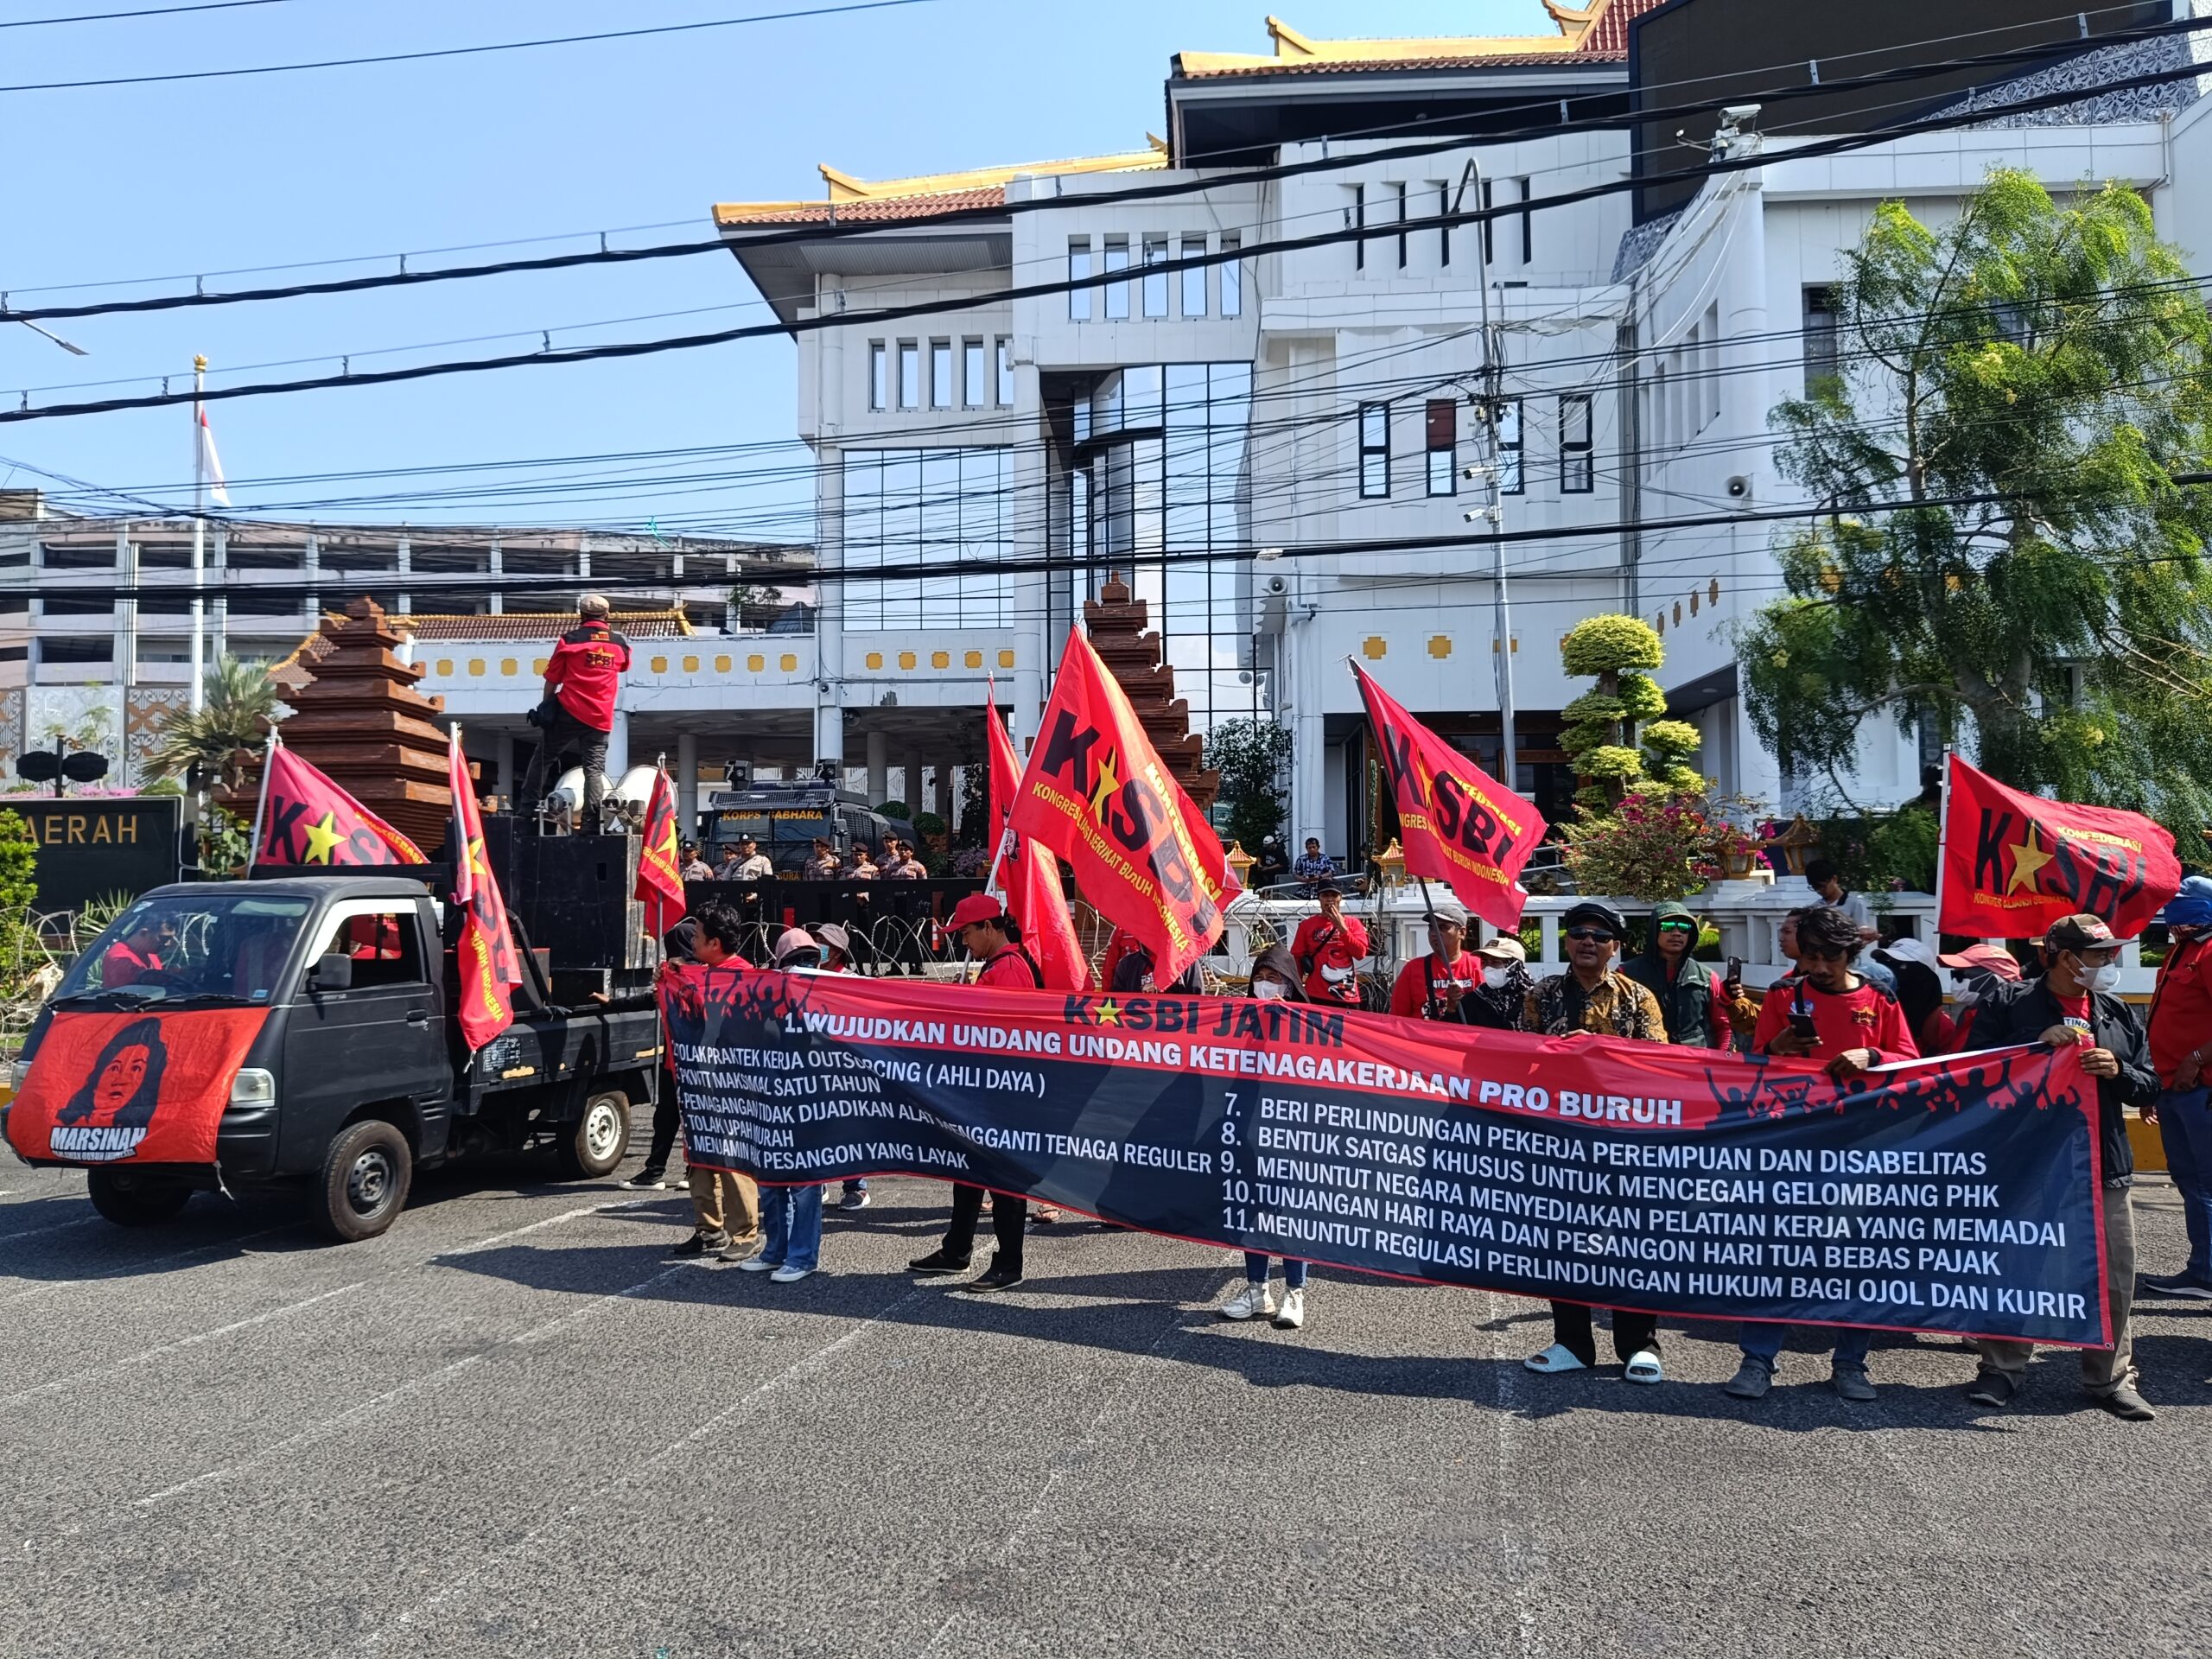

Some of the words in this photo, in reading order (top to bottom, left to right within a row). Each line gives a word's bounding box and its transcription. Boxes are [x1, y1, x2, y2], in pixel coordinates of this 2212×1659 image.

[722, 810, 761, 821] KORPS
[1032, 781, 1081, 820] KONGRES
[2056, 826, 2142, 854] KONFEDERASI
[481, 965, 505, 1022] INDONESIA
[1065, 995, 1199, 1035] KASBI
[1213, 1001, 1345, 1048] JATIM
[707, 1046, 760, 1067] PRAKTEK
[764, 1050, 804, 1071] KERJA
[712, 1071, 772, 1095] MAKSIMAL
[774, 1075, 817, 1096] SATU
[821, 1074, 881, 1093] TAHUN
[953, 1025, 1061, 1054] UNDANG
[1069, 1034, 1181, 1065] UNDANG
[1190, 1045, 1471, 1100] KETENAGAKERJAAN
[1479, 1080, 1549, 1111] PRO
[1559, 1090, 1681, 1125] BURUH
[50, 1127, 147, 1151] MARSINAH
[683, 1092, 758, 1118] PEMAGANGAN
[759, 1102, 796, 1123] TIDAK
[798, 1099, 894, 1122] DIJADIKAN
[899, 1104, 935, 1125] ALAT
[1046, 1134, 1119, 1161] TENAGA
[1124, 1143, 1211, 1174] REGULER
[687, 1115, 725, 1134] TOLAK
[723, 1118, 753, 1139] UPAH
[753, 1123, 794, 1147] MURAH
[693, 1135, 749, 1160] MENJAMIN
[764, 1144, 864, 1170] PESANGON
[865, 1142, 914, 1162] YANG
[918, 1146, 969, 1169] LAYAK
[1224, 1092, 1241, 1116] 7.
[1261, 1097, 1308, 1123] BERI
[1314, 1103, 1480, 1147] PERLINDUNGAN
[1487, 1126, 1586, 1161] PEKERJA
[1593, 1141, 1751, 1172] PEREMPUAN
[1759, 1149, 1812, 1173] DAN
[1820, 1150, 1987, 1175] DISABELITAS
[1221, 1121, 1242, 1147] 8.
[1258, 1127, 1340, 1156] BENTUK
[1344, 1136, 1427, 1168] SATGAS
[1433, 1148, 1524, 1183] KHUSUS
[1531, 1163, 1611, 1196] UNTUK
[1618, 1174, 1764, 1205] MENCEGAH
[1772, 1181, 1938, 1207] GELOMBANG
[1947, 1185, 1999, 1208] PHK
[1220, 1150, 1242, 1174] 9.
[1256, 1156, 1372, 1191] MENUNTUT
[1376, 1171, 1464, 1205] NEGARA
[1470, 1184, 1640, 1230] MENYEDIAKAN
[1649, 1209, 1765, 1237] PELATIAN
[1774, 1215, 1852, 1238] KERJA
[1857, 1217, 1925, 1240] YANG
[1933, 1217, 2066, 1247] MEMADAI
[1385, 1200, 1434, 1229] HARI
[1440, 1210, 1495, 1241] RAYA
[1502, 1221, 1548, 1249] DAN
[1556, 1230, 1694, 1263] PESANGON
[1703, 1241, 1762, 1267] HARI
[1769, 1243, 1817, 1268] TUA
[1824, 1246, 1910, 1270] BEBAS
[1918, 1249, 2001, 1276] PAJAK
[1376, 1230, 1480, 1269] REGULASI
[1487, 1251, 1681, 1294] PERLINDUNGAN
[1688, 1273, 1783, 1298] HUKUM
[1790, 1277, 1851, 1300] BAGI
[1859, 1279, 1924, 1306] OJOL
[1931, 1282, 1988, 1311] DAN
[1998, 1288, 2087, 1319] KURIR
